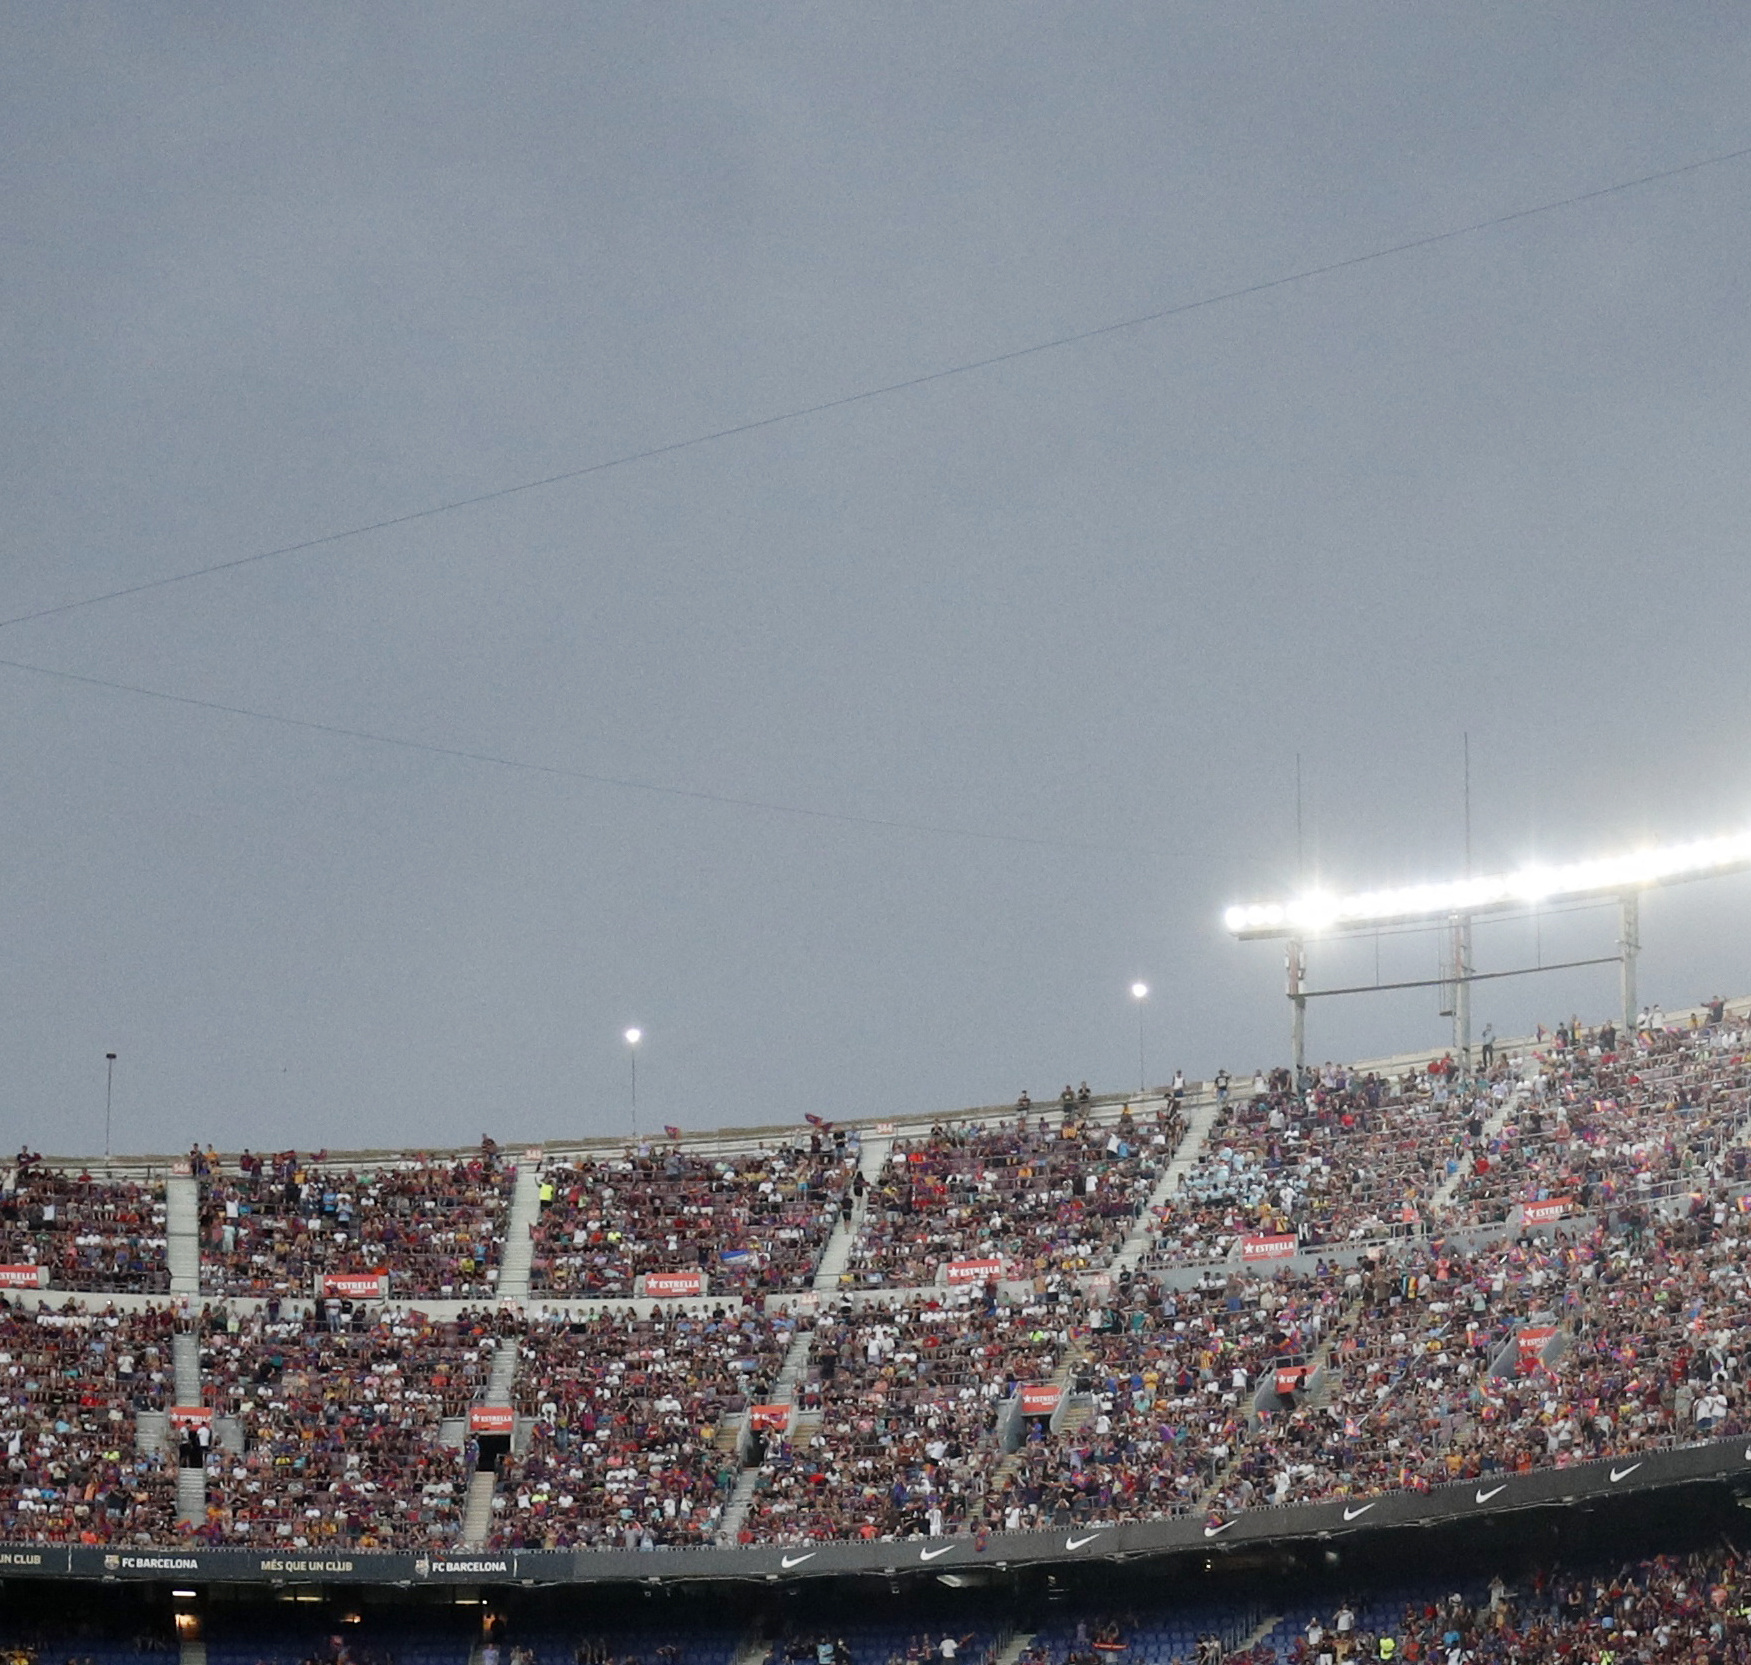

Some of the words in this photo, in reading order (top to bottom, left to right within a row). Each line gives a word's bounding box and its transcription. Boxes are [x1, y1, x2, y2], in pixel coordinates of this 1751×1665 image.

[13, 1554, 41, 1565] CLUB
[122, 1557, 136, 1568] FC
[137, 1557, 198, 1570] BARCELONA
[261, 1559, 283, 1571] MÉS
[285, 1561, 307, 1573] QUE
[309, 1561, 324, 1572] UN
[325, 1561, 353, 1572] CLUB
[432, 1561, 446, 1572] FC
[447, 1561, 507, 1573] BARCELONA
